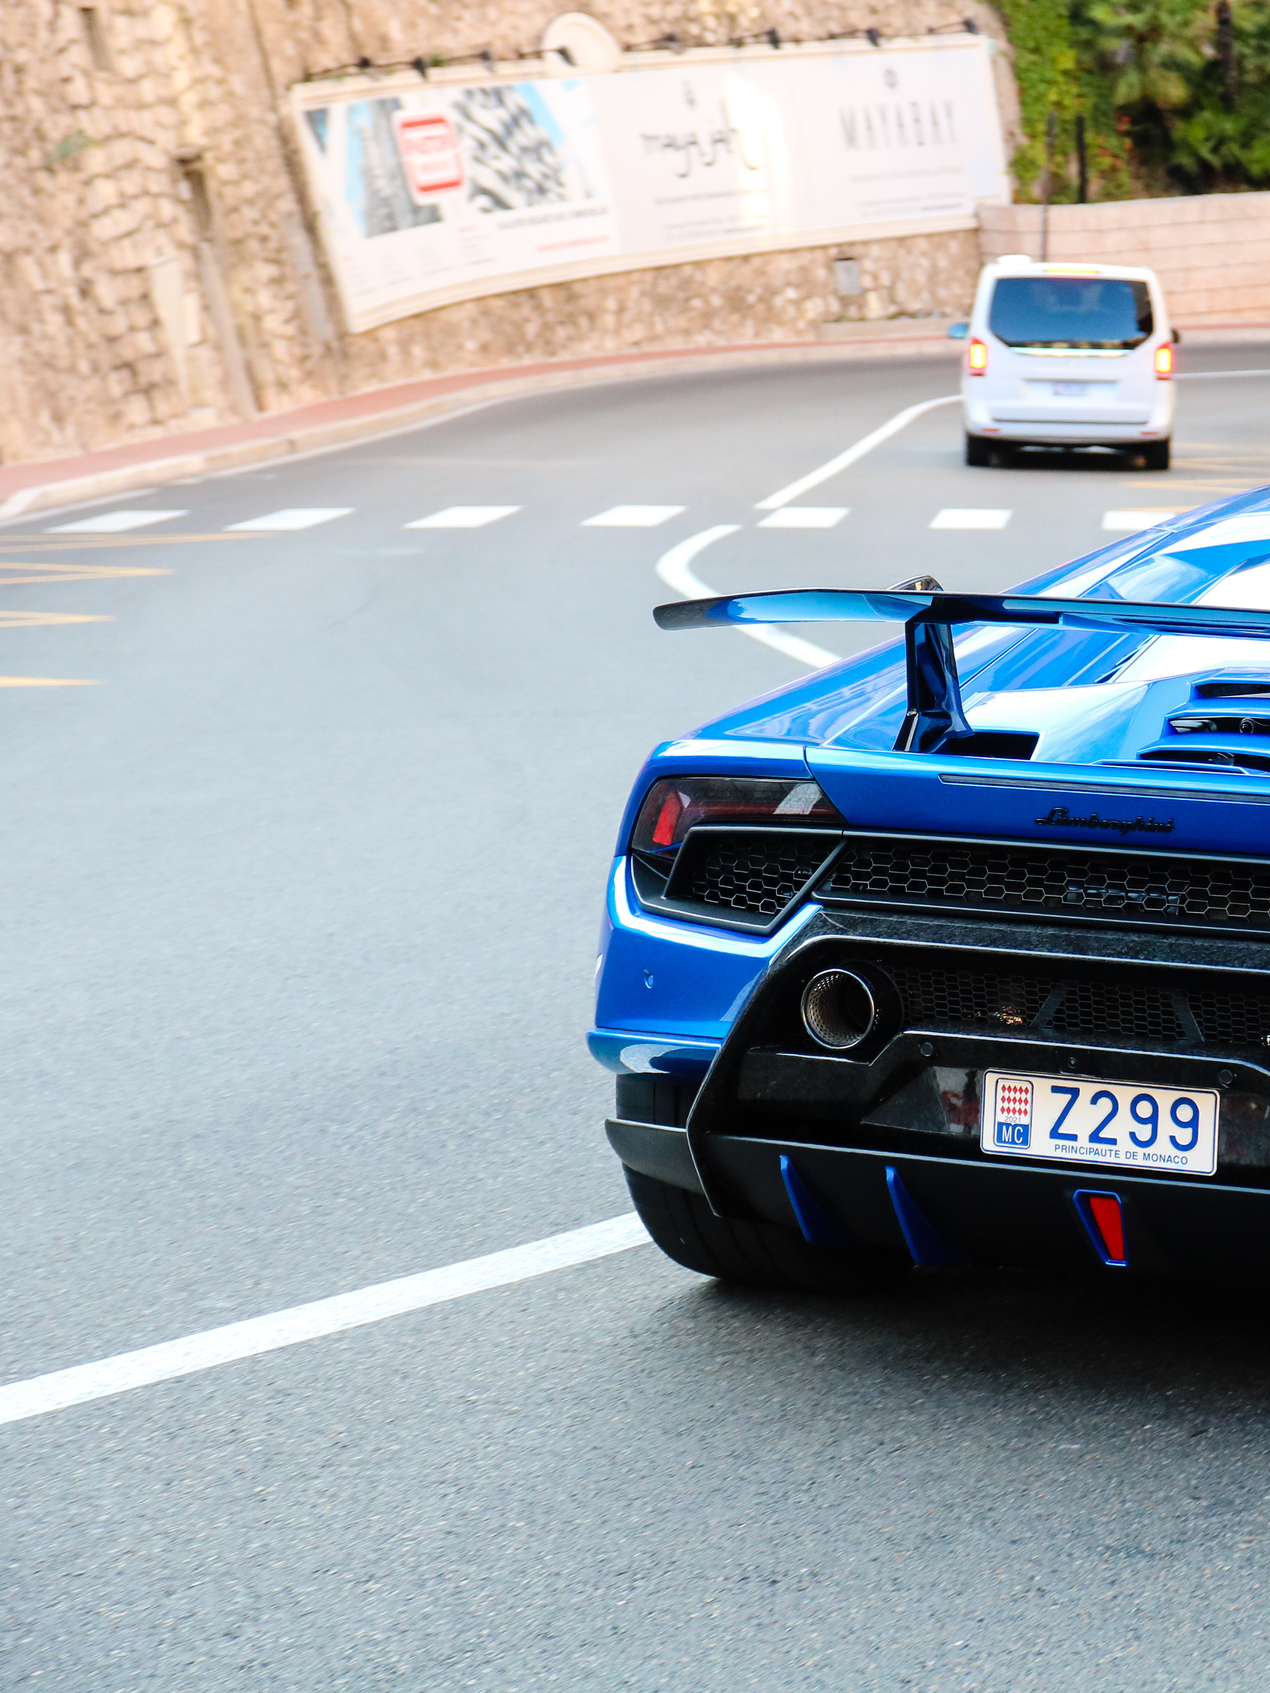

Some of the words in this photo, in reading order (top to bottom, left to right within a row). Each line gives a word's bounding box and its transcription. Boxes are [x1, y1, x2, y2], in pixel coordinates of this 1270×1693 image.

[1035, 807, 1175, 835] Lamborghini
[1004, 1116, 1021, 1124] 2021
[1049, 1085, 1200, 1151] Z299
[1002, 1125, 1023, 1143] MC
[1054, 1144, 1120, 1159] PRINCIPAUTE
[1125, 1151, 1138, 1160] DE
[1142, 1152, 1188, 1165] MONACO
